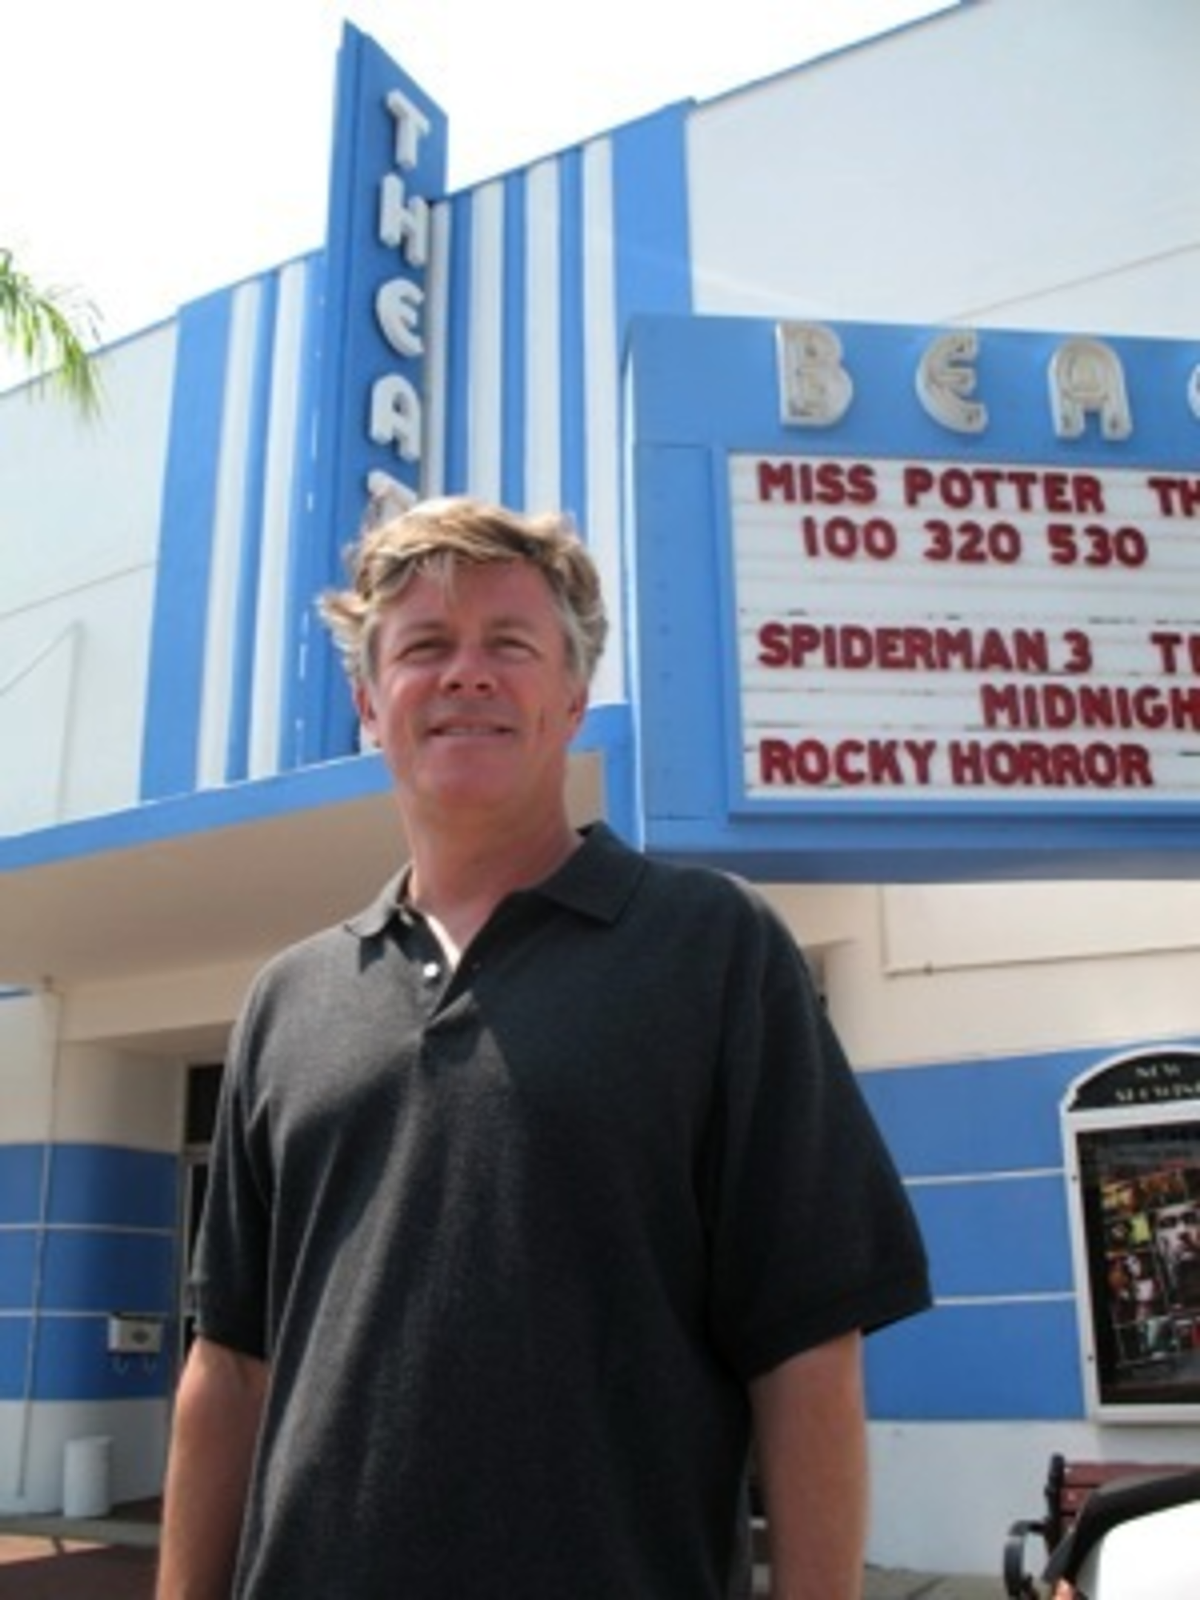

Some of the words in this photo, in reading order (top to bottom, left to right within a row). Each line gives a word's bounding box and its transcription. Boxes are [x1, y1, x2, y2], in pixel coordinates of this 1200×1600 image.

[776, 319, 1200, 441] BEA
[757, 462, 877, 505] MISS
[903, 467, 1105, 513] POTTER
[802, 516, 898, 559] 100
[924, 521, 1021, 564] 320
[1047, 524, 1148, 568] 530
[758, 622, 1047, 672] SPIDERMAN
[1063, 630, 1092, 674] 3
[980, 684, 1200, 730] MIDNIGH
[760, 739, 936, 785] ROCKY
[950, 743, 1153, 786] HORROR
